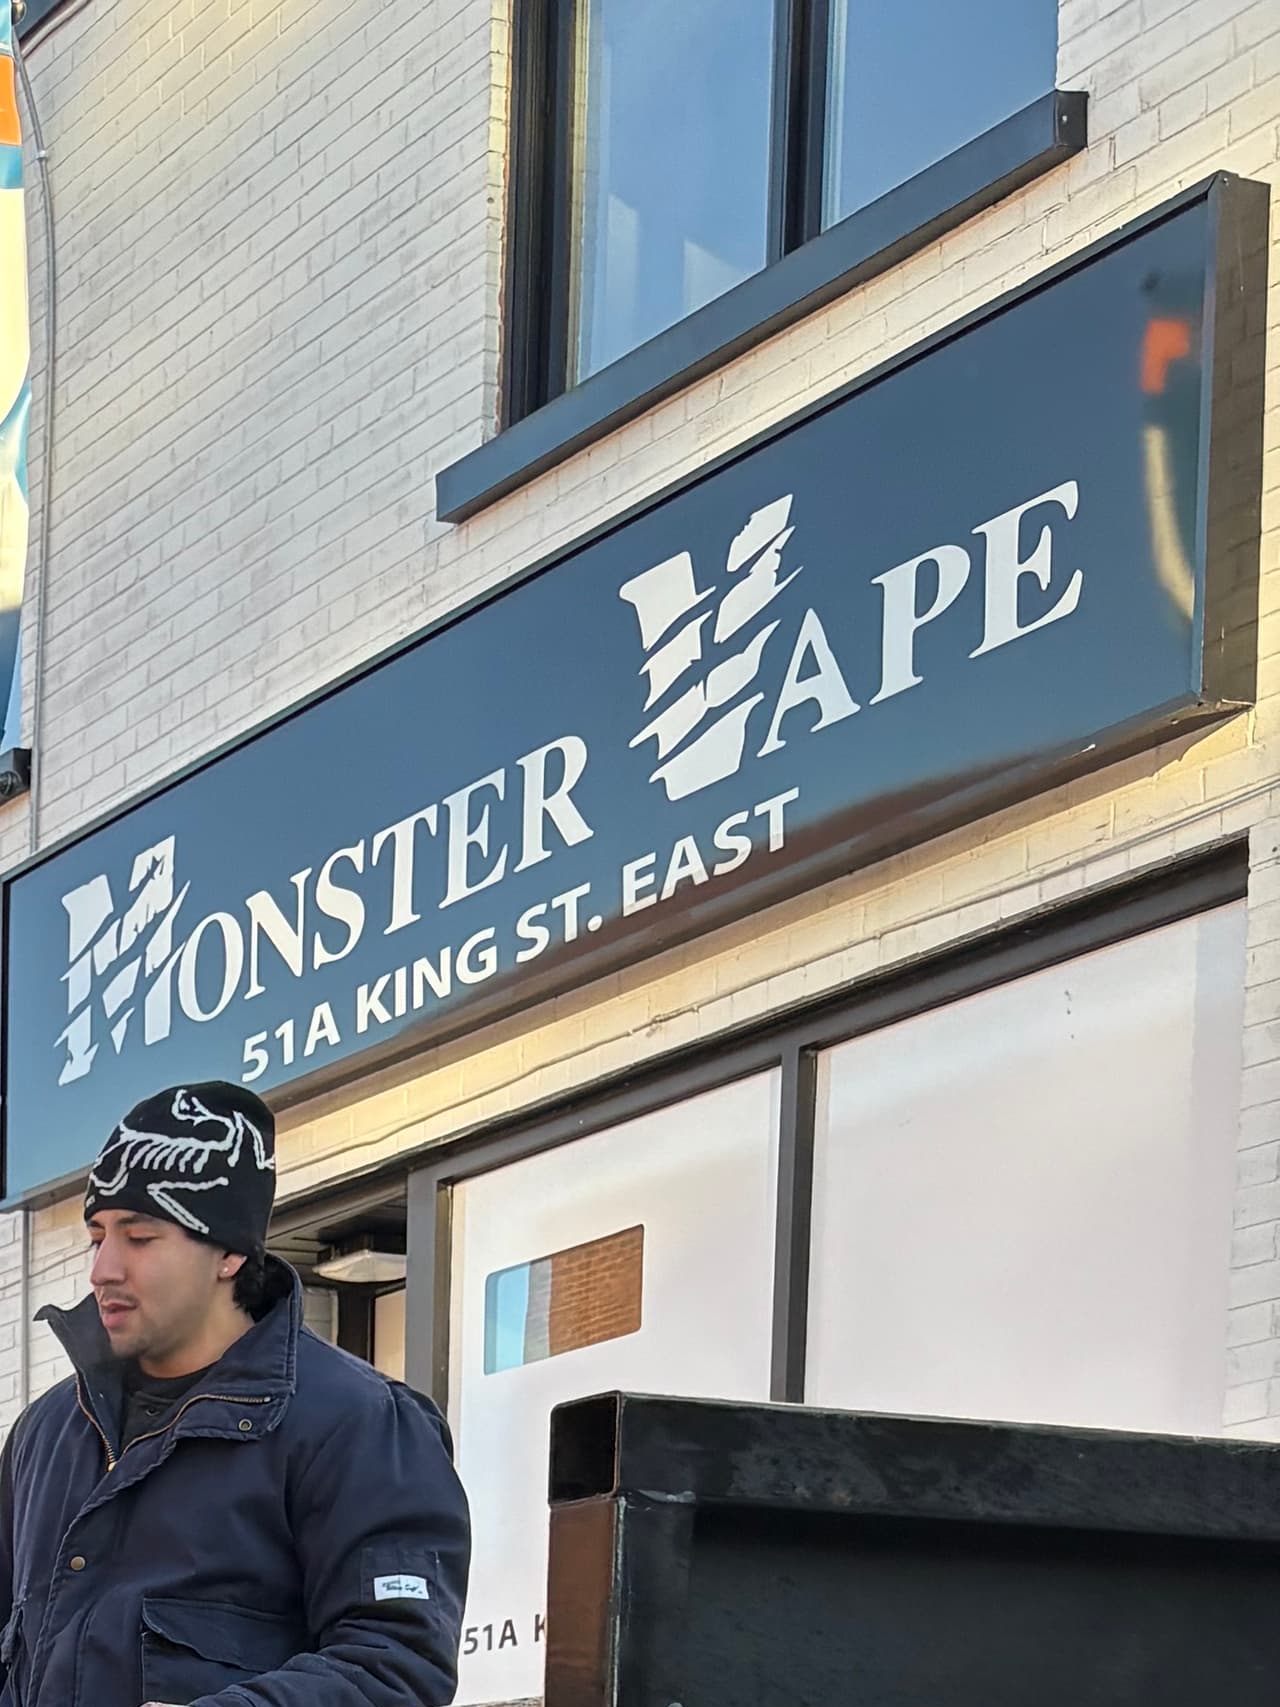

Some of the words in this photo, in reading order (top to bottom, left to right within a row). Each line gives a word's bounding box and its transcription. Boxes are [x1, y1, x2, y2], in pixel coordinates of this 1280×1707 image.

[56, 733, 595, 1086] MONSTER
[618, 478, 1082, 800] VAPE
[242, 1003, 341, 1083] 51A
[356, 938, 499, 1032] KING
[515, 883, 603, 966] ST.
[623, 786, 800, 919] EAST
[463, 1619, 518, 1655] 51A
